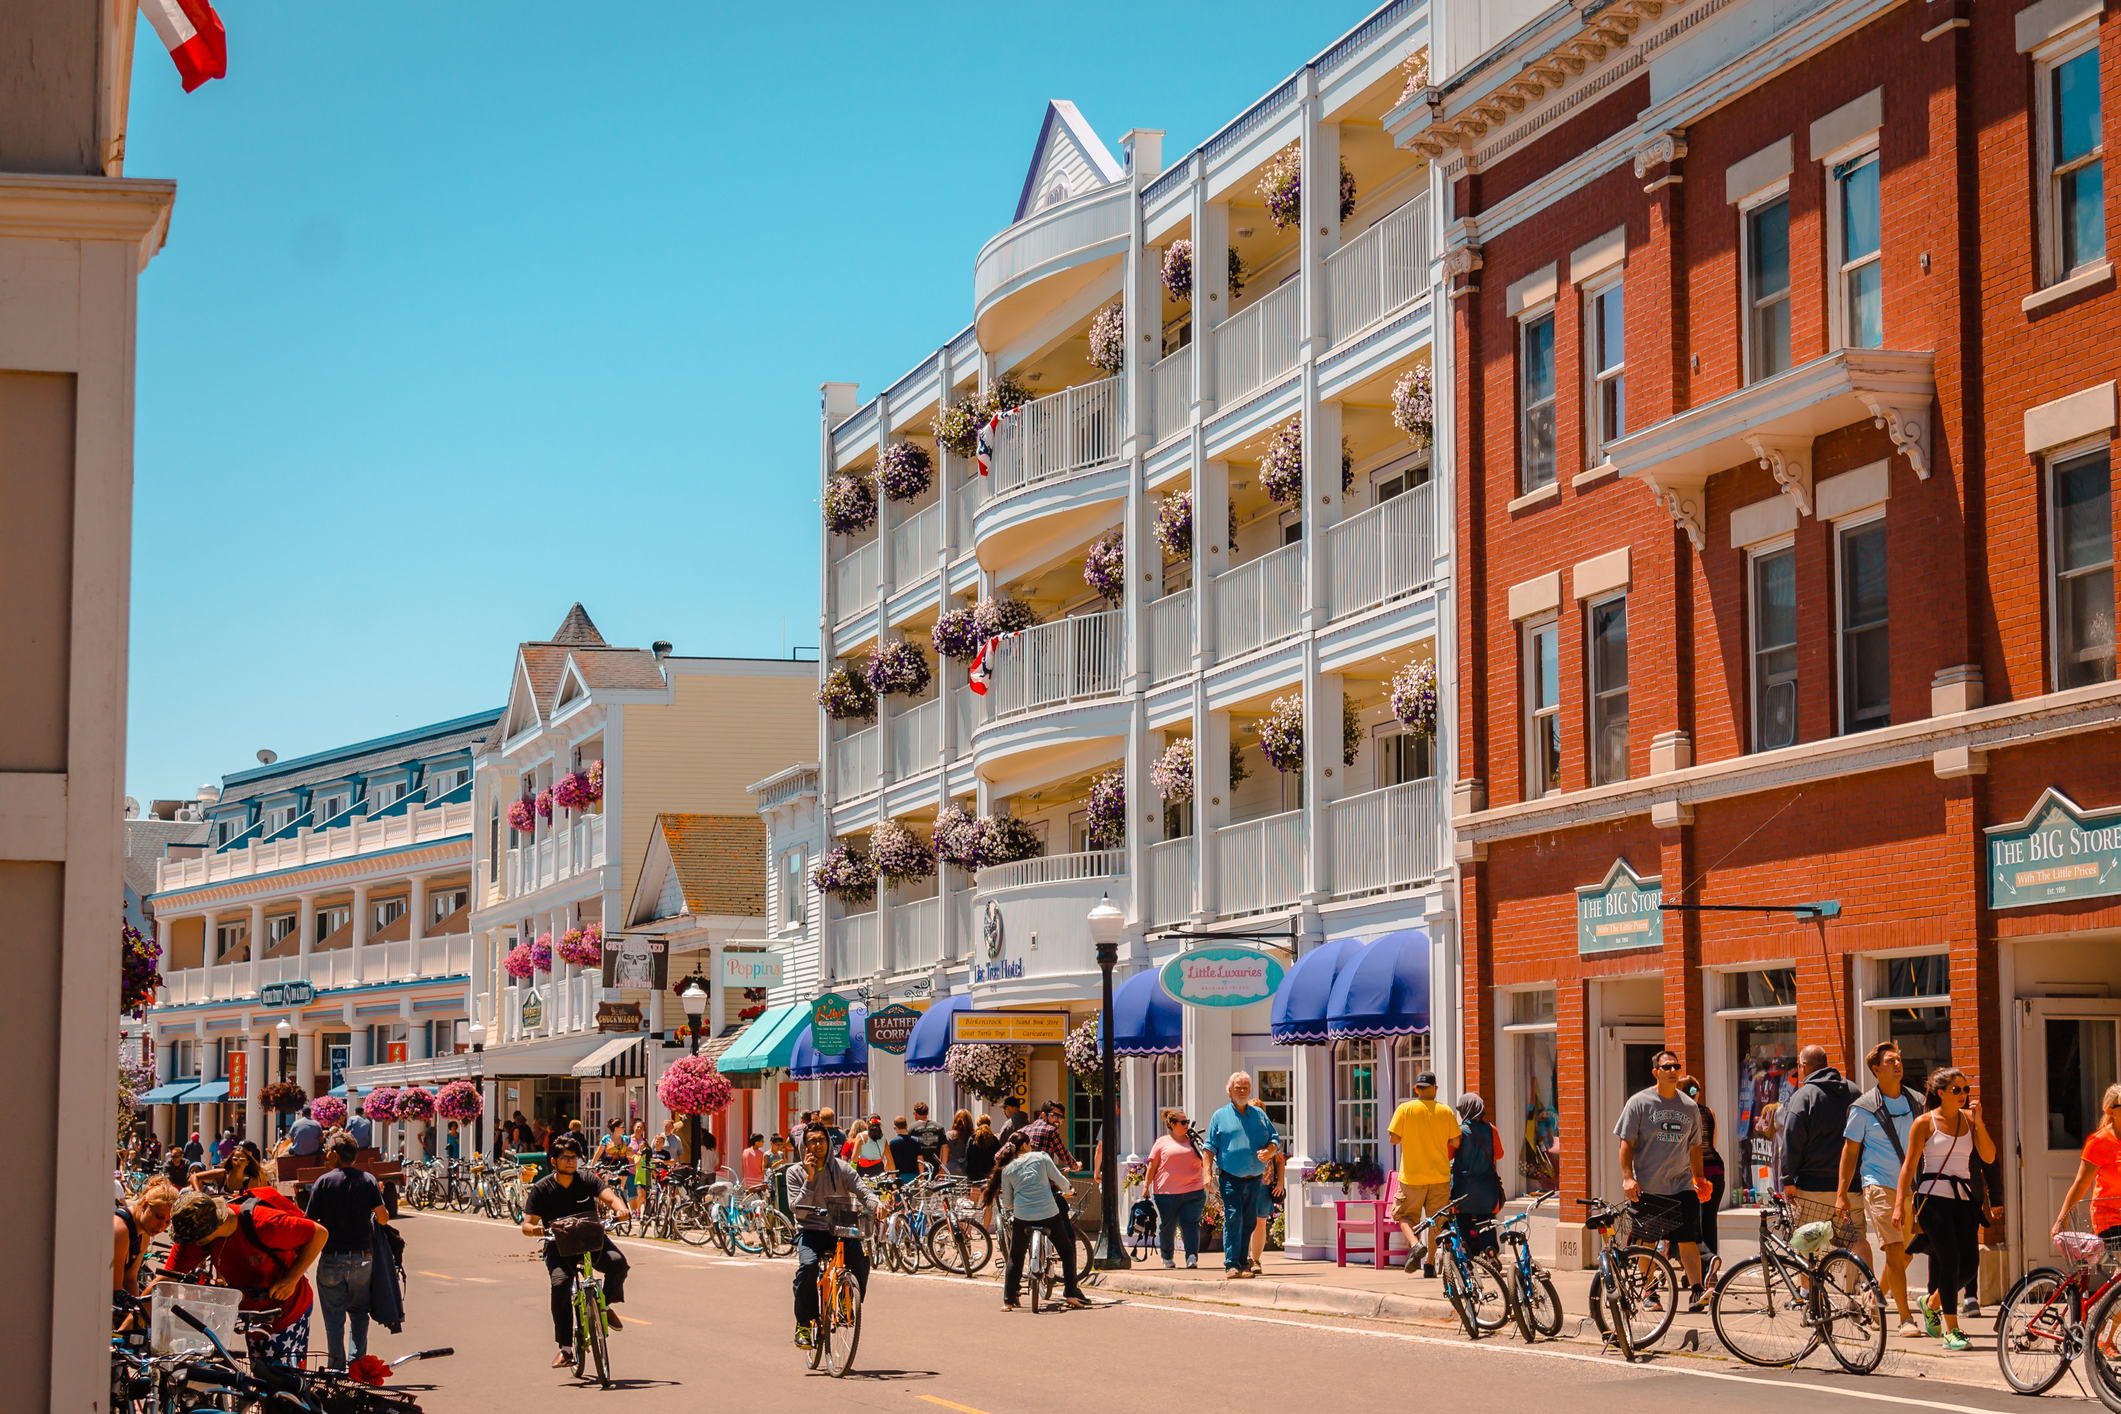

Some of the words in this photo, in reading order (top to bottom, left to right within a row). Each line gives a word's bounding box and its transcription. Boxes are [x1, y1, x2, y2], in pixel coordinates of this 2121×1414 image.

[1992, 839, 2025, 867] THE
[2029, 829, 2064, 862] BIG
[2070, 827, 2121, 856] STORE
[2017, 873, 2035, 884] With
[2036, 871, 2051, 881] The
[2052, 869, 2072, 880] Little
[2074, 866, 2097, 877] Prices
[1581, 897, 1602, 919] THE
[1606, 891, 1628, 916] BIG
[1610, 924, 1619, 933] The
[1620, 923, 1633, 932] Little
[1633, 922, 1648, 931] Prices
[605, 941, 623, 951] GET
[623, 943, 665, 953] SPOOKED
[726, 958, 780, 980] Poppins
[1000, 957, 1023, 979] Hotel
[1187, 965, 1216, 979] Little
[1216, 965, 1262, 979] Luxuries
[873, 1017, 919, 1029] LEATHER
[875, 1029, 912, 1040] CORRA
[961, 1030, 975, 1038] Great
[994, 1030, 1006, 1038] Toys
[233, 1055, 241, 1095] LEGO
